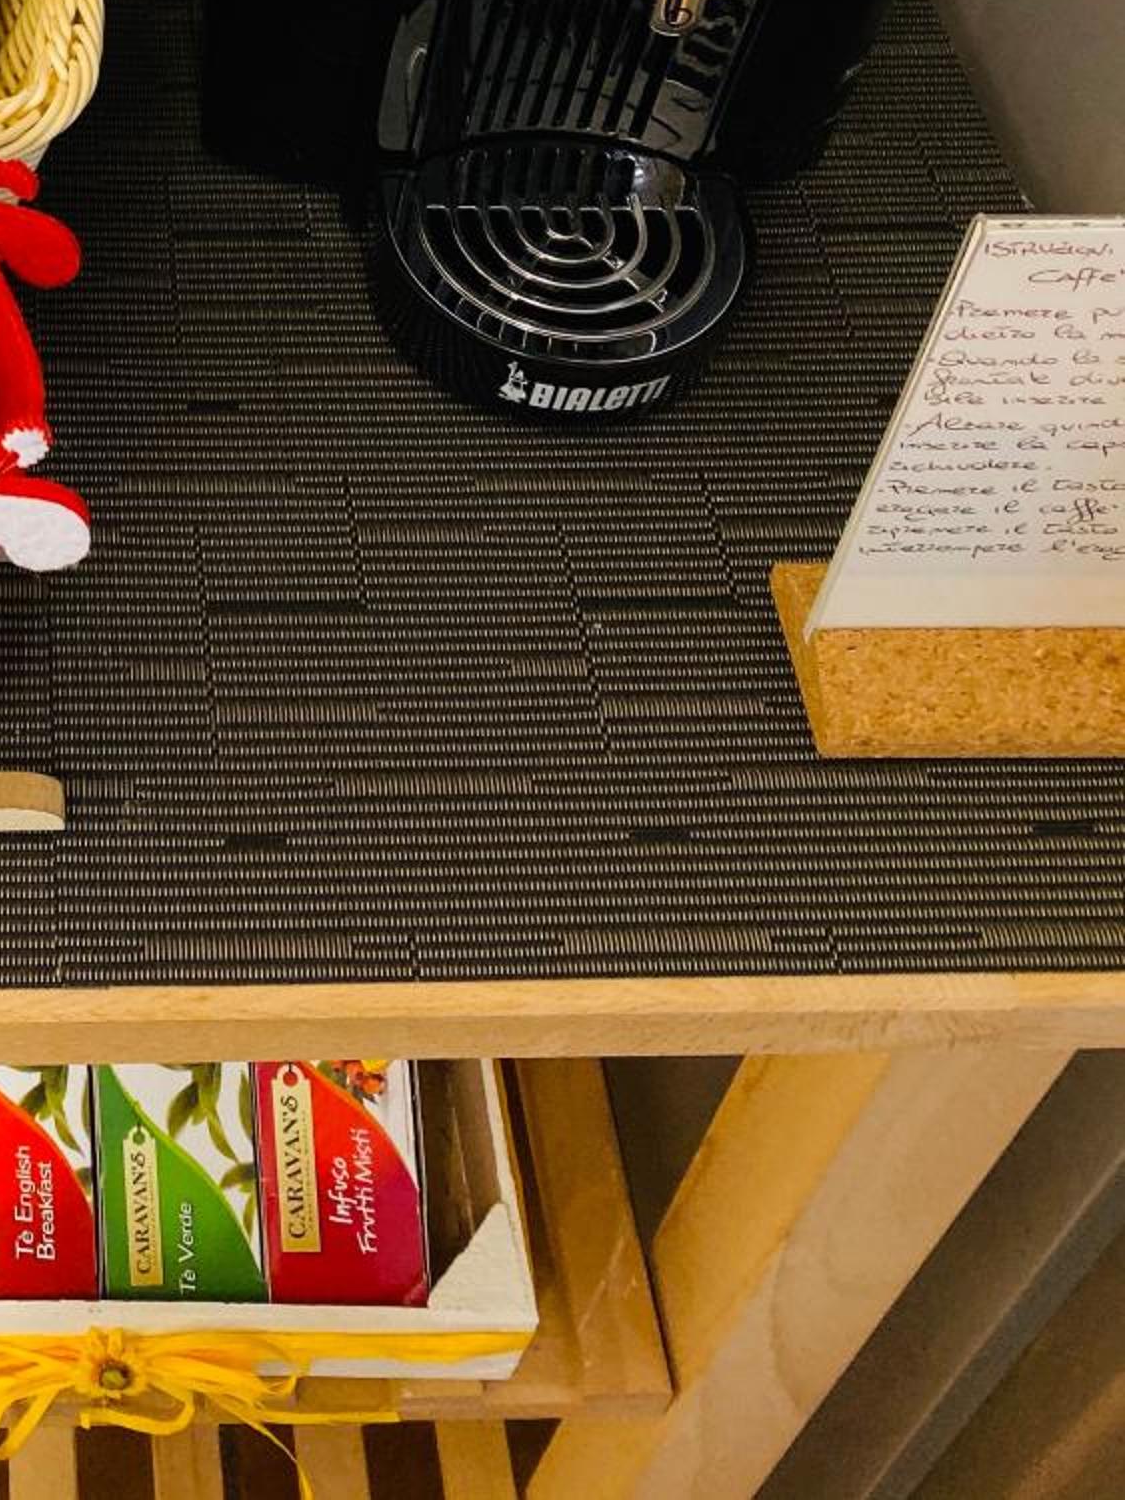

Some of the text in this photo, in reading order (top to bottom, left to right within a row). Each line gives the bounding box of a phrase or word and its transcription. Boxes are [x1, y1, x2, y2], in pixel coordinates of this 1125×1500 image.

[15, 1146, 35, 1222] English
[37, 1161, 56, 1259] Breakfast
[131, 1152, 151, 1274] CARAVAN'S
[281, 1096, 306, 1239] CARAVAN'S
[328, 1157, 355, 1224] Infuso
[351, 1128, 377, 1254] Frutti Misti
[177, 1203, 195, 1262] Verde
